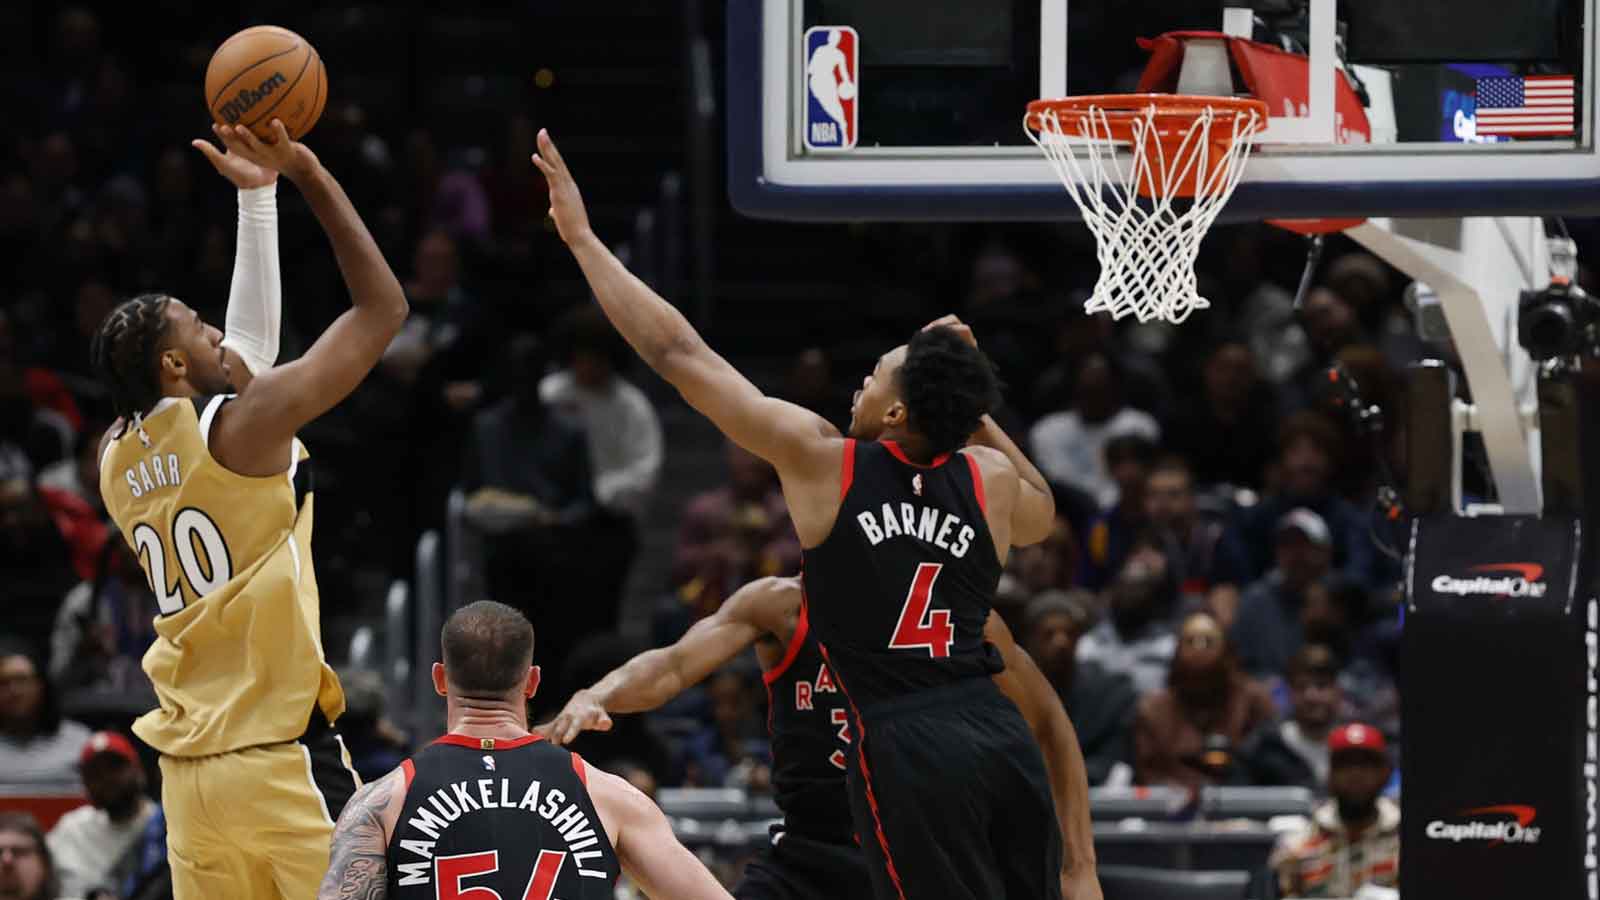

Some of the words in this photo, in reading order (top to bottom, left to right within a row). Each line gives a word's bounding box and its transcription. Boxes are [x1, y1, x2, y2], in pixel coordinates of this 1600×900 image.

[217, 71, 287, 124] Wilson
[811, 121, 838, 143] NBA
[125, 452, 181, 498] SARR
[856, 501, 976, 559] BARNES
[132, 506, 234, 617] 20
[887, 562, 954, 658] 4
[396, 777, 608, 887] MAMUKELASHVILI
